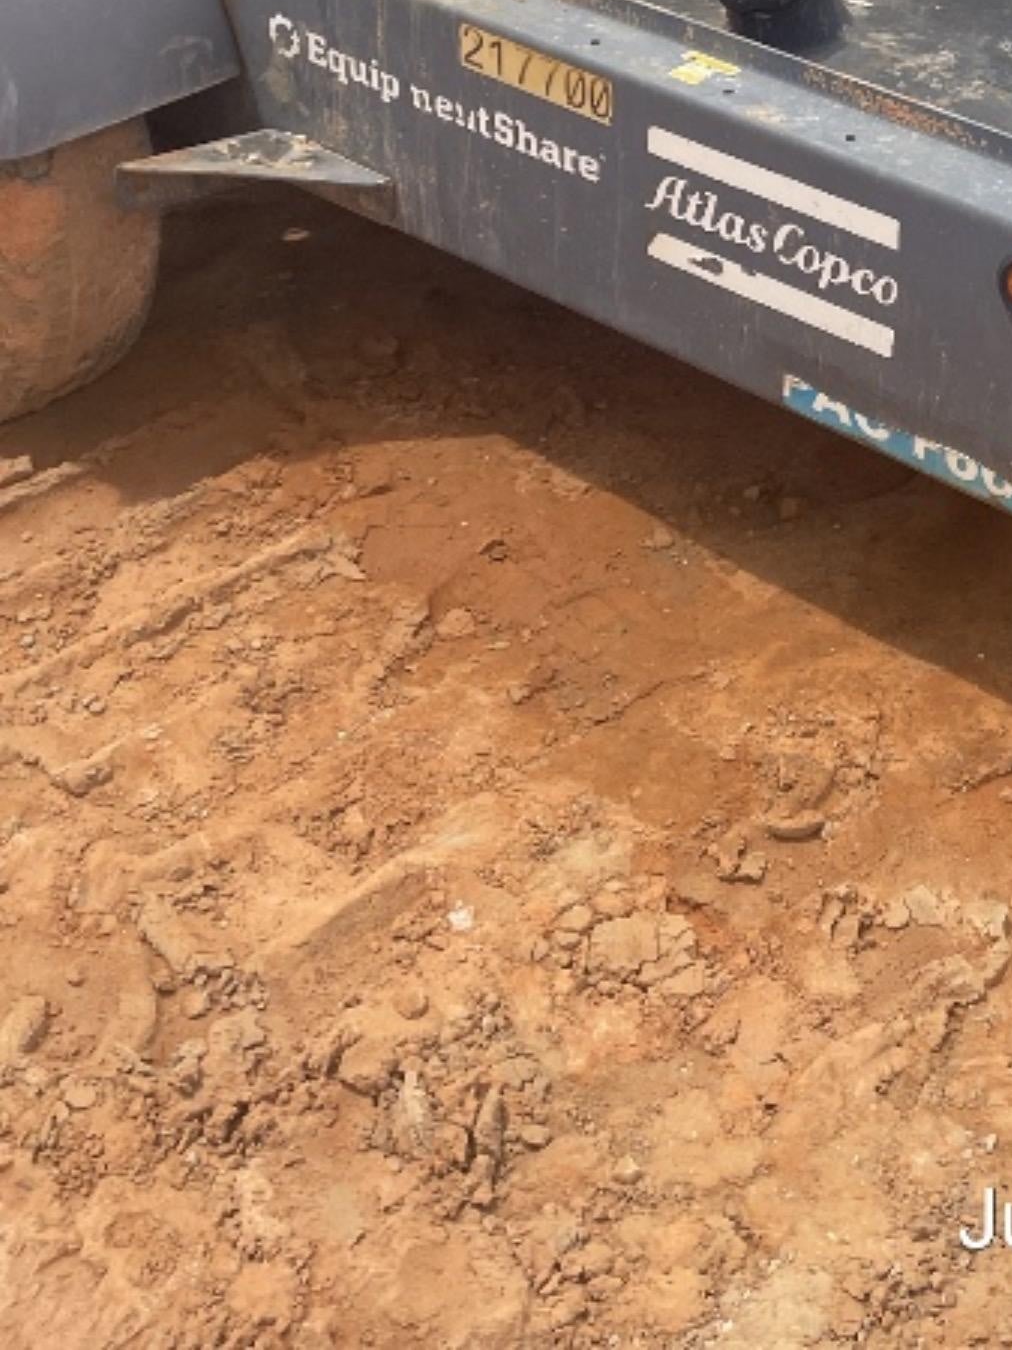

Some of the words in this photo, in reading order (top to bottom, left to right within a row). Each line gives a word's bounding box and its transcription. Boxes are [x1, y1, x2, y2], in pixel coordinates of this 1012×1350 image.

[463, 24, 612, 119] 217700
[644, 175, 768, 252] Atlas
[774, 223, 898, 305] Copco
